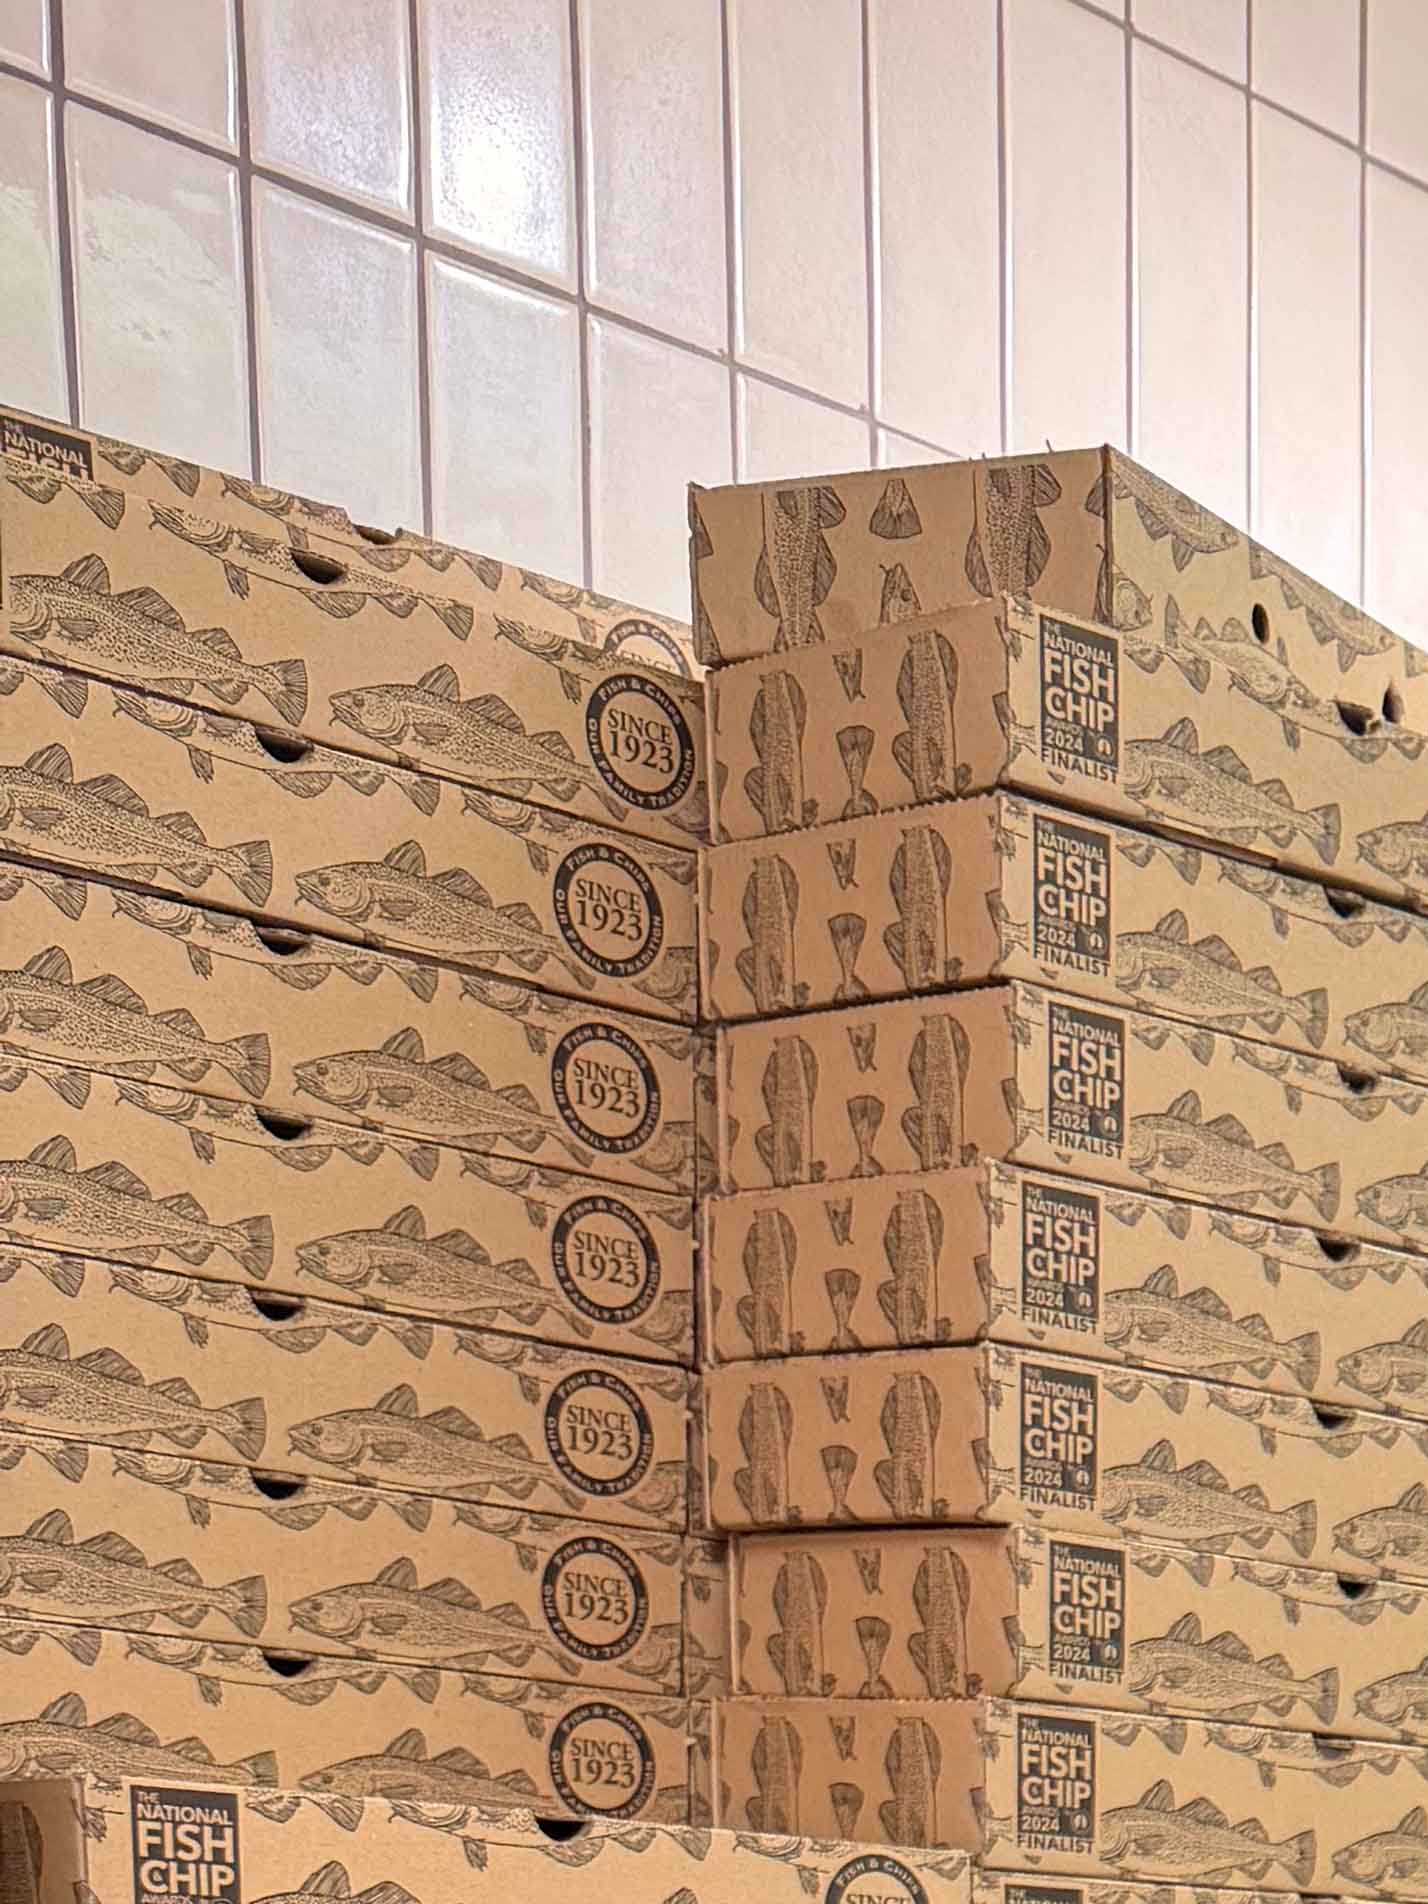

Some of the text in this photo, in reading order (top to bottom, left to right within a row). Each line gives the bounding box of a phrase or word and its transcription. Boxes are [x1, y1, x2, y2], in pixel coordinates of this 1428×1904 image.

[4, 431, 88, 468] NATIONAL
[1044, 632, 1114, 667] NATIONAL
[1045, 648, 1115, 703] FISH
[1045, 684, 1115, 734] CHIP
[608, 709, 674, 747] SINCE
[1045, 728, 1083, 753] 2024
[610, 731, 675, 777] 1923
[1041, 747, 1119, 785] FINALIST
[1037, 831, 1106, 863] NATIONAL
[1038, 847, 1107, 898] FISH
[576, 879, 643, 914] SINCE
[1038, 882, 1106, 928] CHIP
[578, 901, 643, 943] 1923
[1038, 925, 1075, 948] 2024
[1034, 944, 1110, 978] FINALIST
[1053, 1018, 1121, 1047] NATIONAL
[574, 1058, 640, 1090] SINCE
[1053, 1033, 1121, 1081] FISH
[575, 1080, 641, 1119] 1923
[1053, 1068, 1121, 1111] CHIP
[1053, 1110, 1089, 1132] 2024
[1048, 1129, 1124, 1160] FINALIST
[1026, 1198, 1095, 1224] NATIONAL
[574, 1231, 640, 1261] SINCE
[1027, 1212, 1096, 1257] FISH
[576, 1252, 640, 1289] 1923
[1026, 1247, 1095, 1287] CHIP
[1026, 1288, 1063, 1308] 2024
[1022, 1306, 1098, 1334] FINALIST
[567, 1405, 633, 1433] SINCE
[1025, 1393, 1094, 1435] FISH
[569, 1426, 633, 1461] 1923
[1025, 1427, 1093, 1464] CHIP
[563, 1573, 628, 1598] SINCE
[1054, 1571, 1122, 1610] FISH
[565, 1593, 628, 1626] 1923
[1054, 1604, 1121, 1639] CHIP
[571, 1739, 635, 1761] SINCE
[1022, 1743, 1092, 1780] FISH
[572, 1759, 636, 1788] 1923
[137, 1792, 160, 1803] THE
[1022, 1776, 1091, 1808] CHIP
[137, 1804, 232, 1825] NATIONAL
[138, 1821, 235, 1863] FISH
[140, 1860, 235, 1896] CHIP
